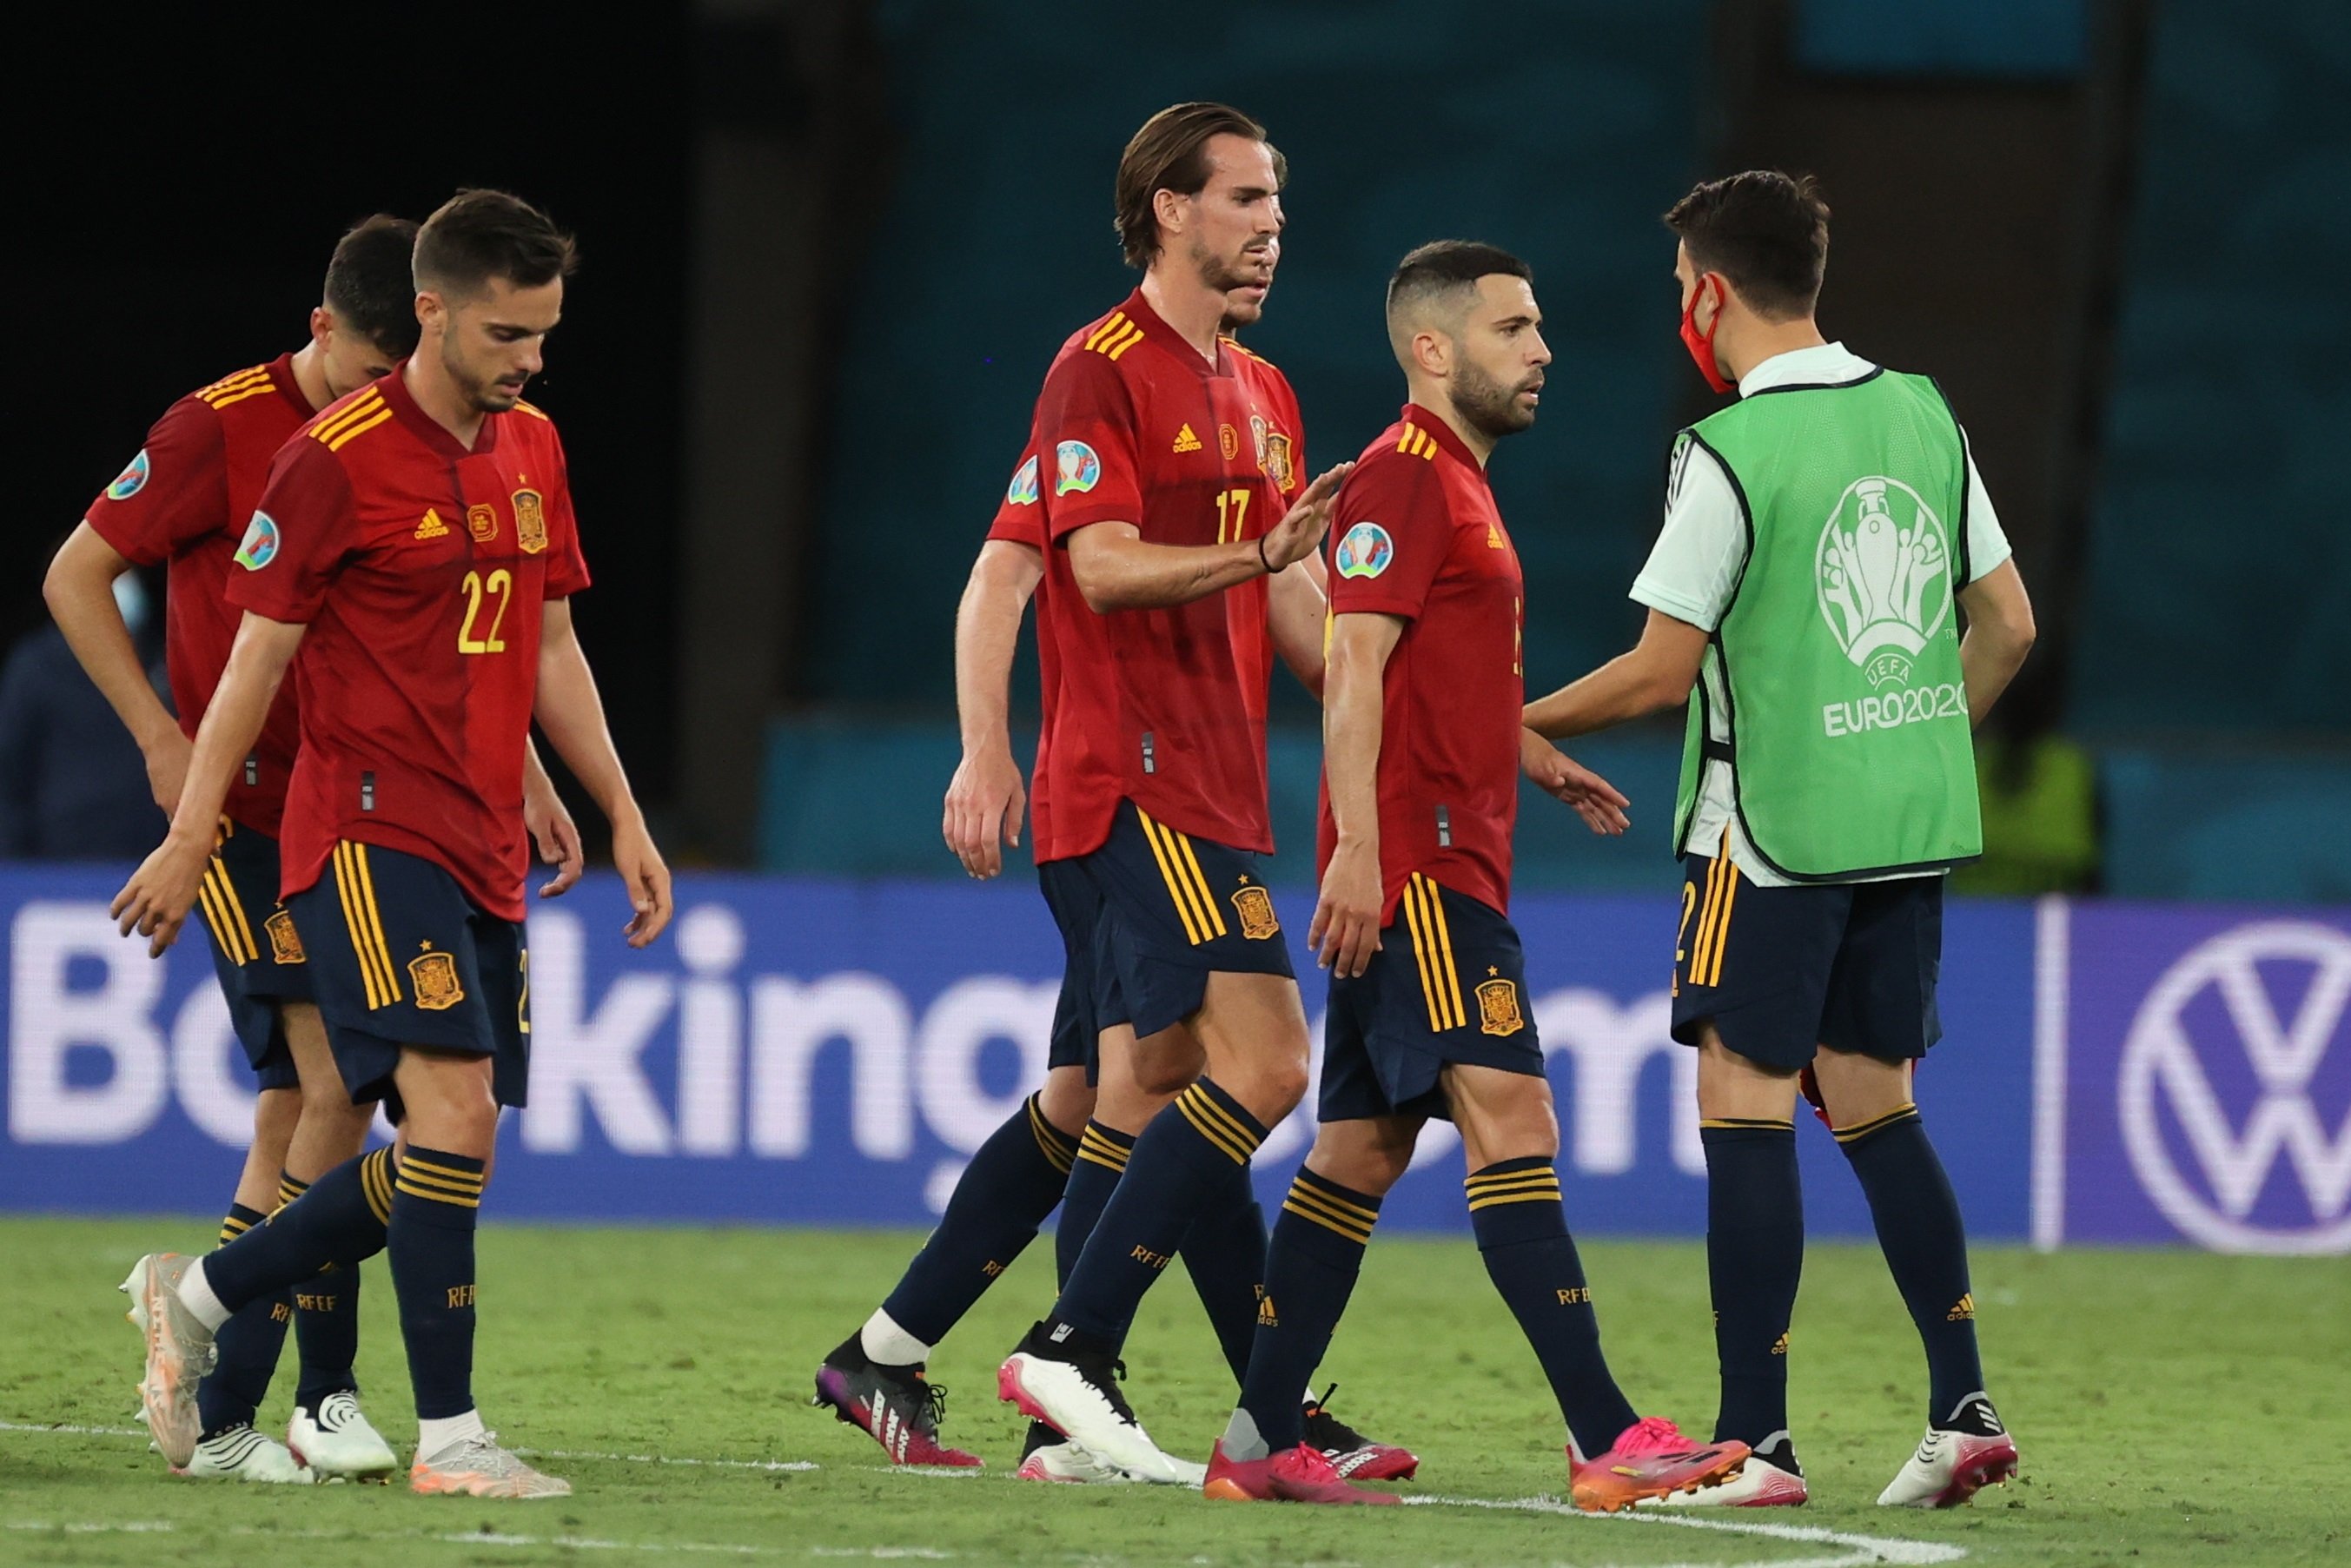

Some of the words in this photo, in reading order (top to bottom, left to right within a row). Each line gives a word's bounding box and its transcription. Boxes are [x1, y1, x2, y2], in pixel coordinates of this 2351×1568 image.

[1216, 489, 1251, 545] 17
[458, 569, 512, 654] 22
[1867, 658, 1910, 686] UEFA
